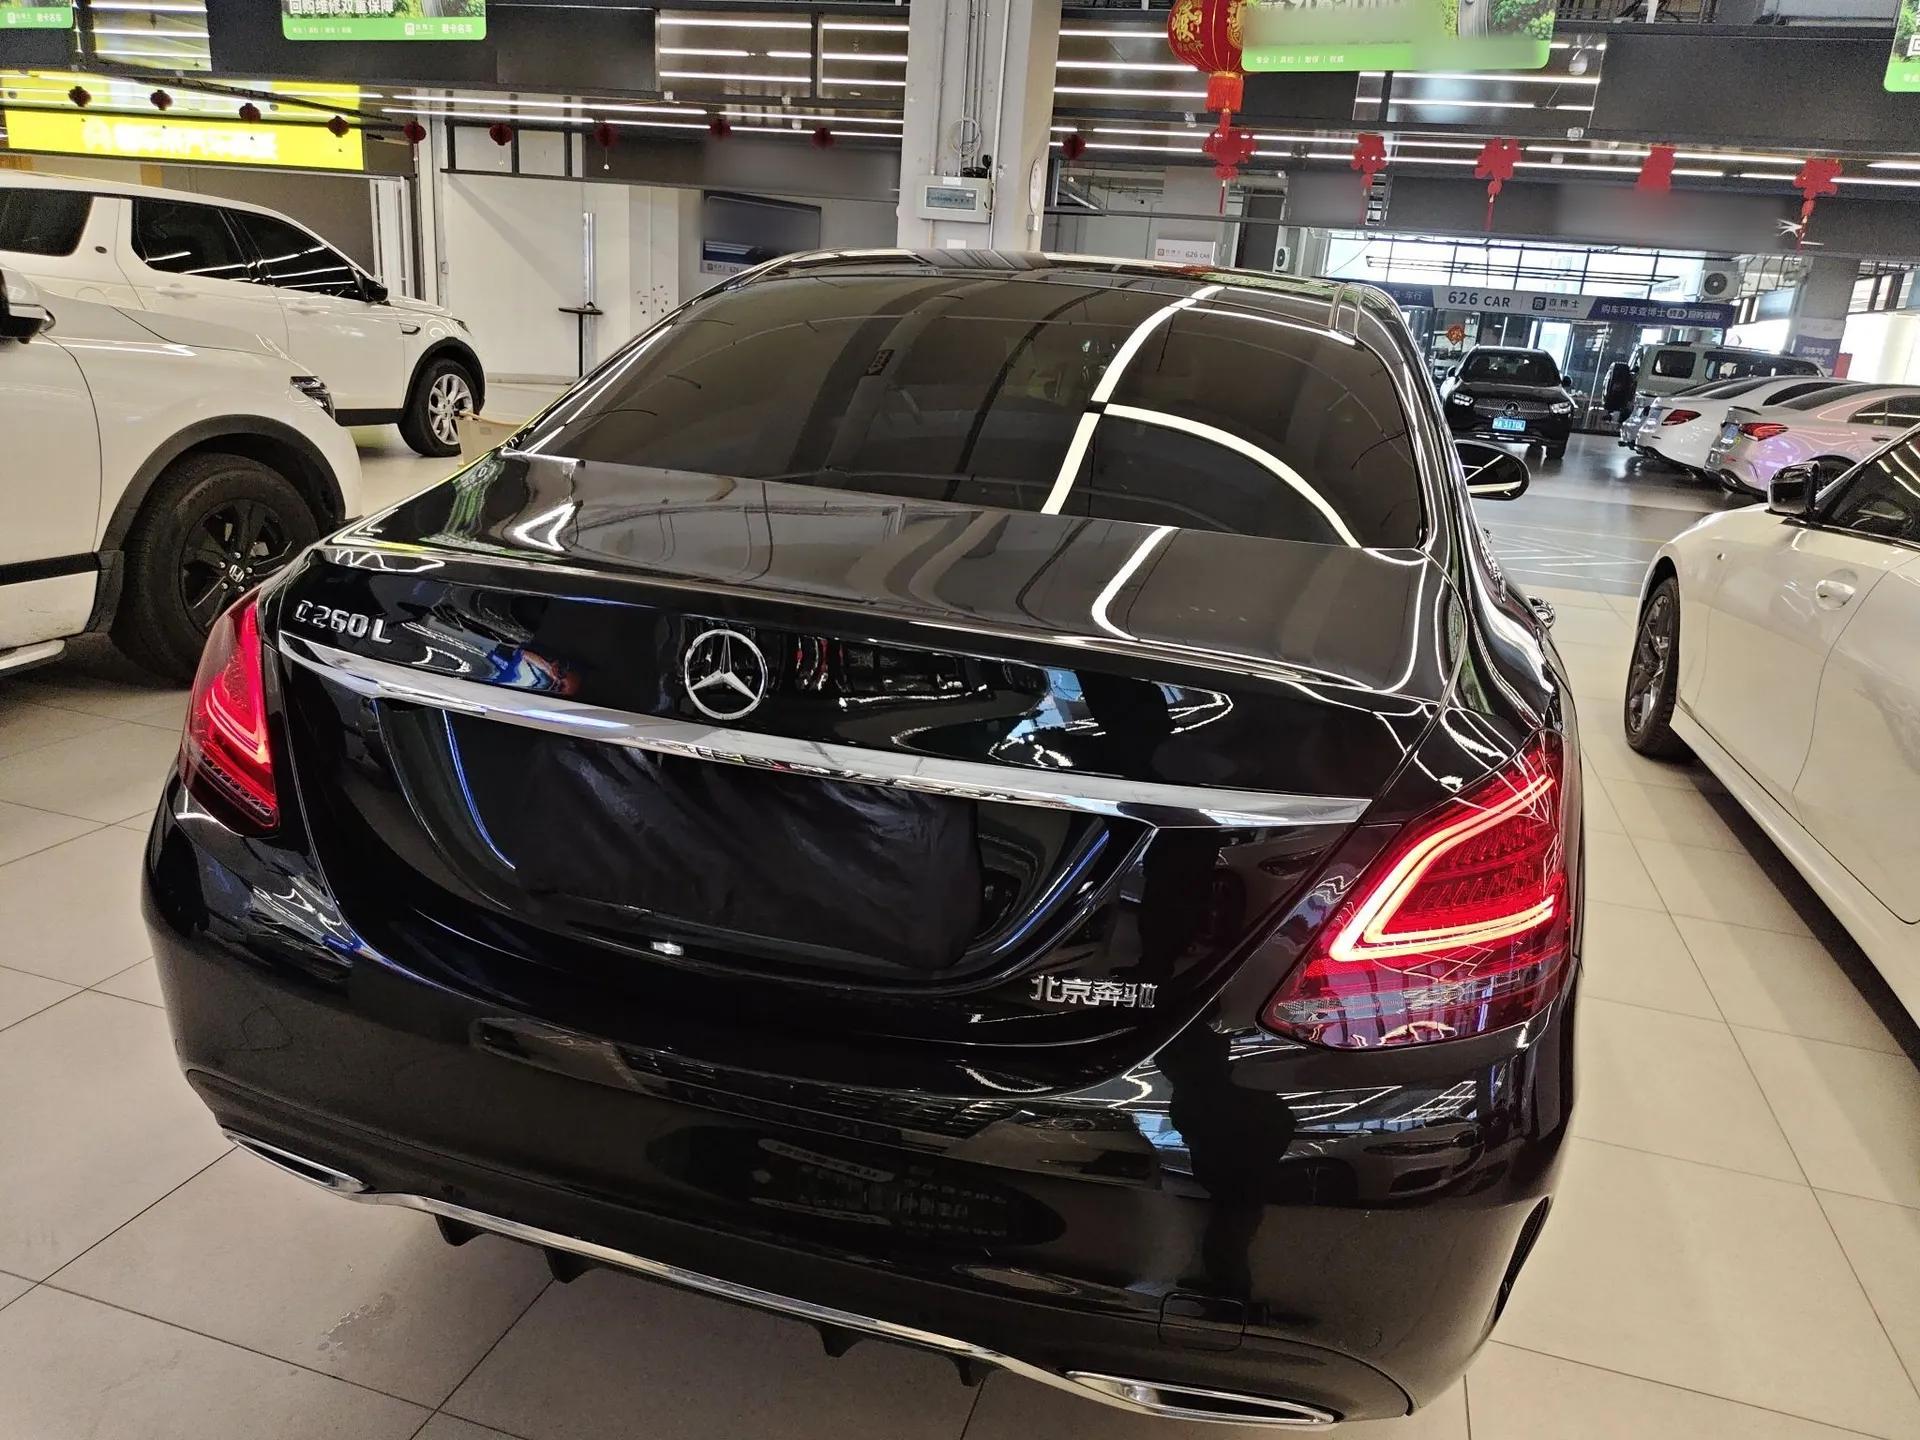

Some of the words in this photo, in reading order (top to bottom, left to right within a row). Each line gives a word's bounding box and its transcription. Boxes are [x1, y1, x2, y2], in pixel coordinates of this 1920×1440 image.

[1448, 290, 1479, 305] 626
[1484, 294, 1511, 308] CAR
[1601, 303, 1668, 318] 购车可享查博士
